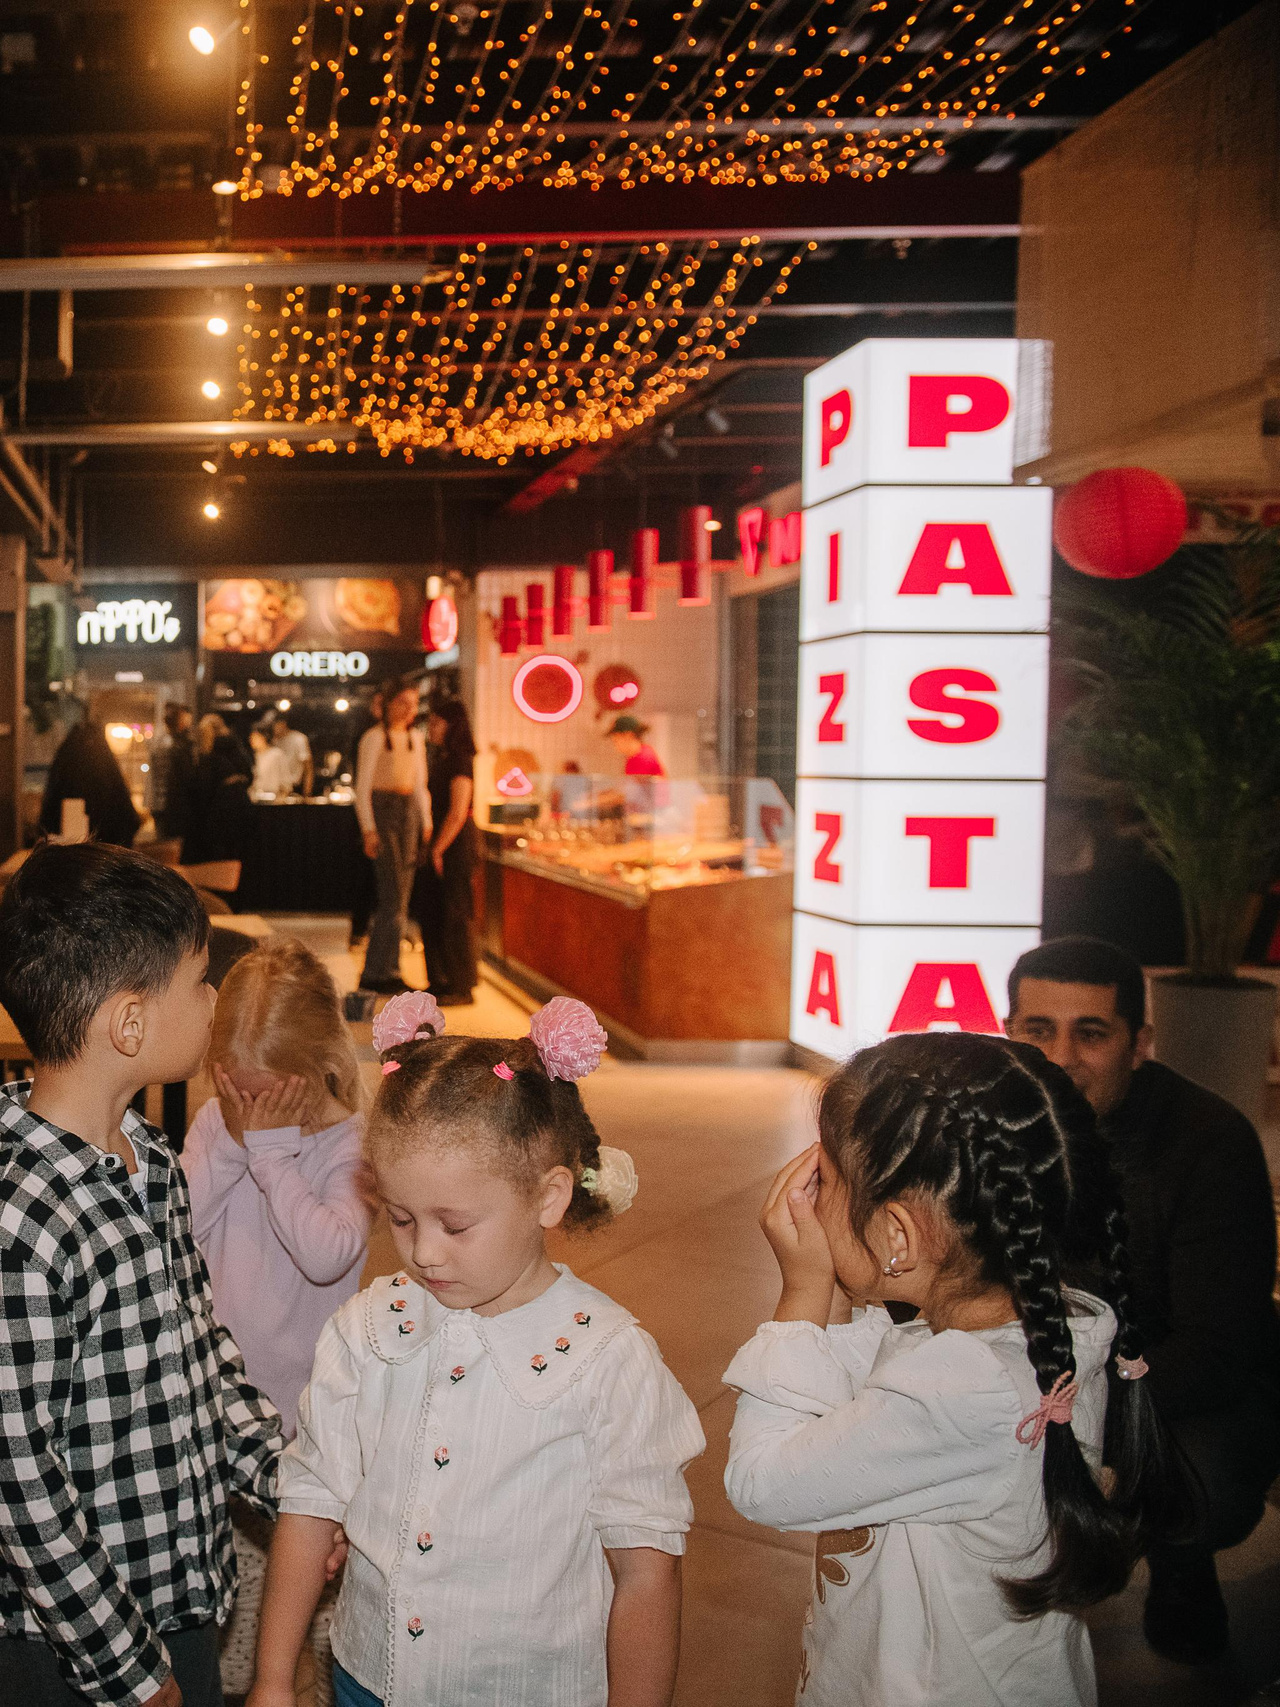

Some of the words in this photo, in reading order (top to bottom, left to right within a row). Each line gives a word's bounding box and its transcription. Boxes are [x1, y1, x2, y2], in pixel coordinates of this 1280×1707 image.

[270, 651, 370, 677] ORERO
[806, 388, 852, 1028] PIZZA
[888, 375, 1015, 1034] PASTA
